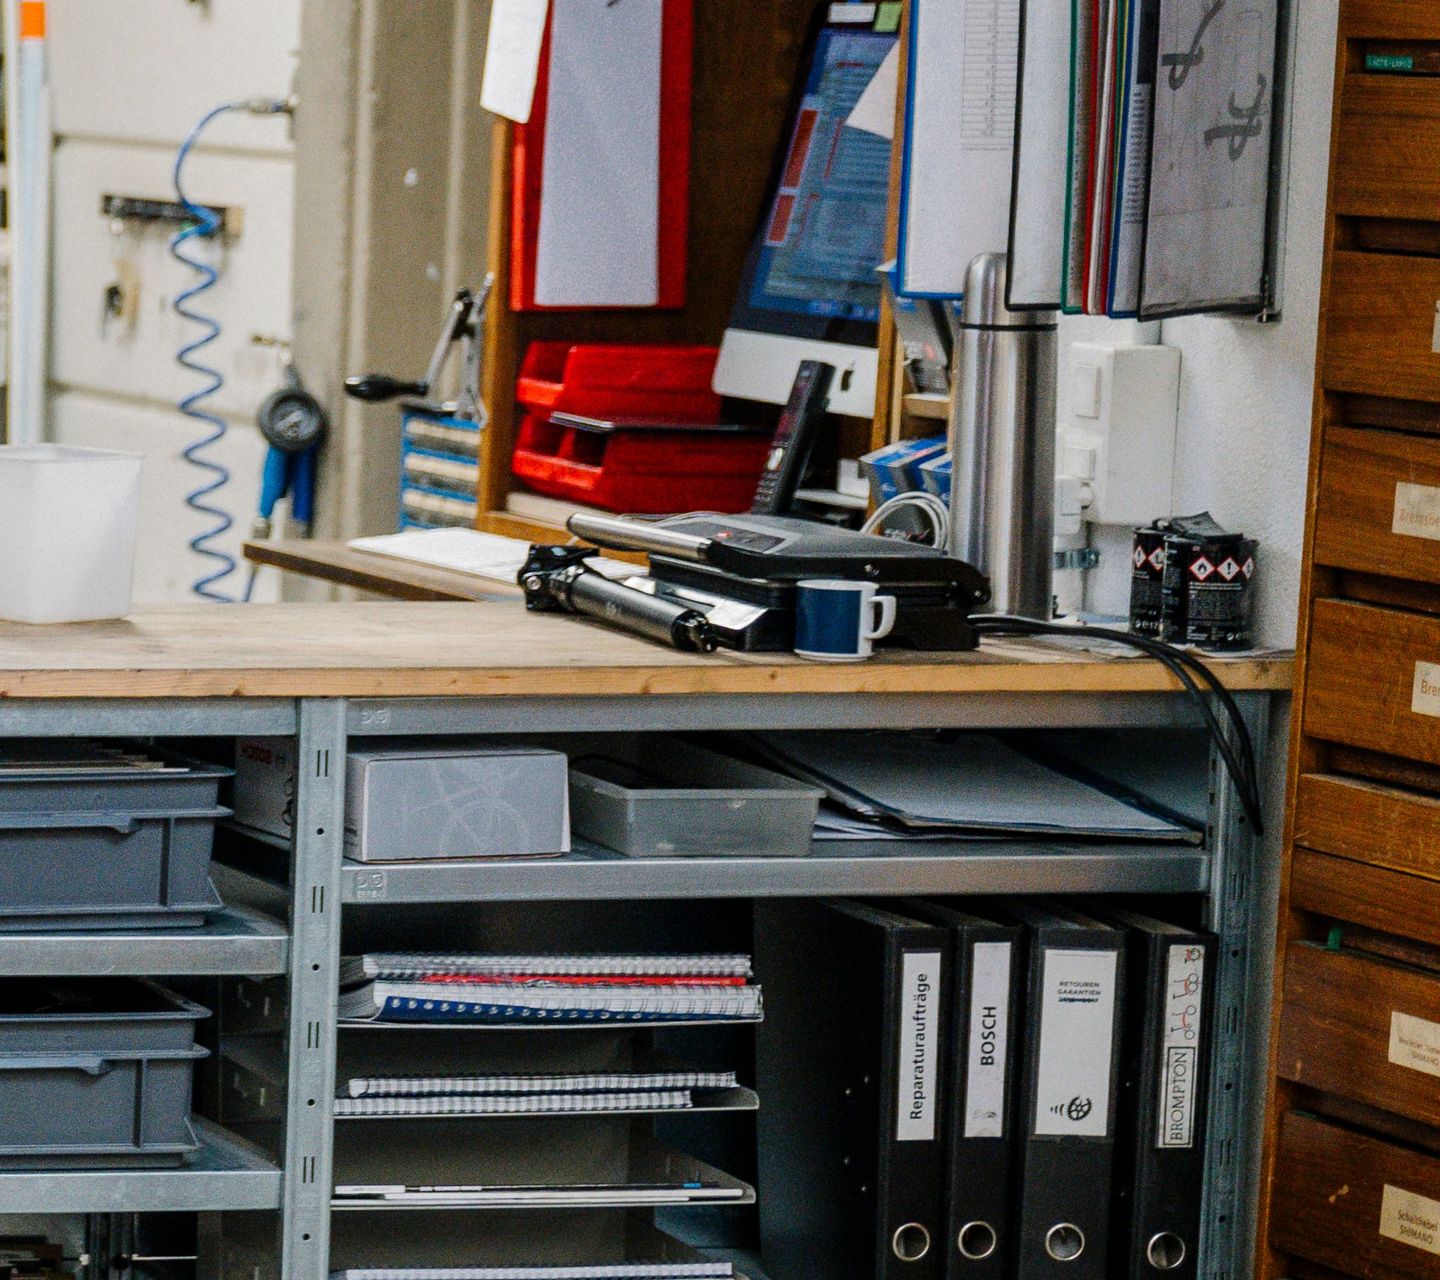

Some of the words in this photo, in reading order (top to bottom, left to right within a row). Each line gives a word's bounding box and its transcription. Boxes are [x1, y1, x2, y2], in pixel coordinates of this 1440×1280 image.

[910, 973, 930, 1120] Reparaturaufträge
[980, 1006, 997, 1066] BOSCH
[1170, 1051, 1188, 1141] BROMPTON
